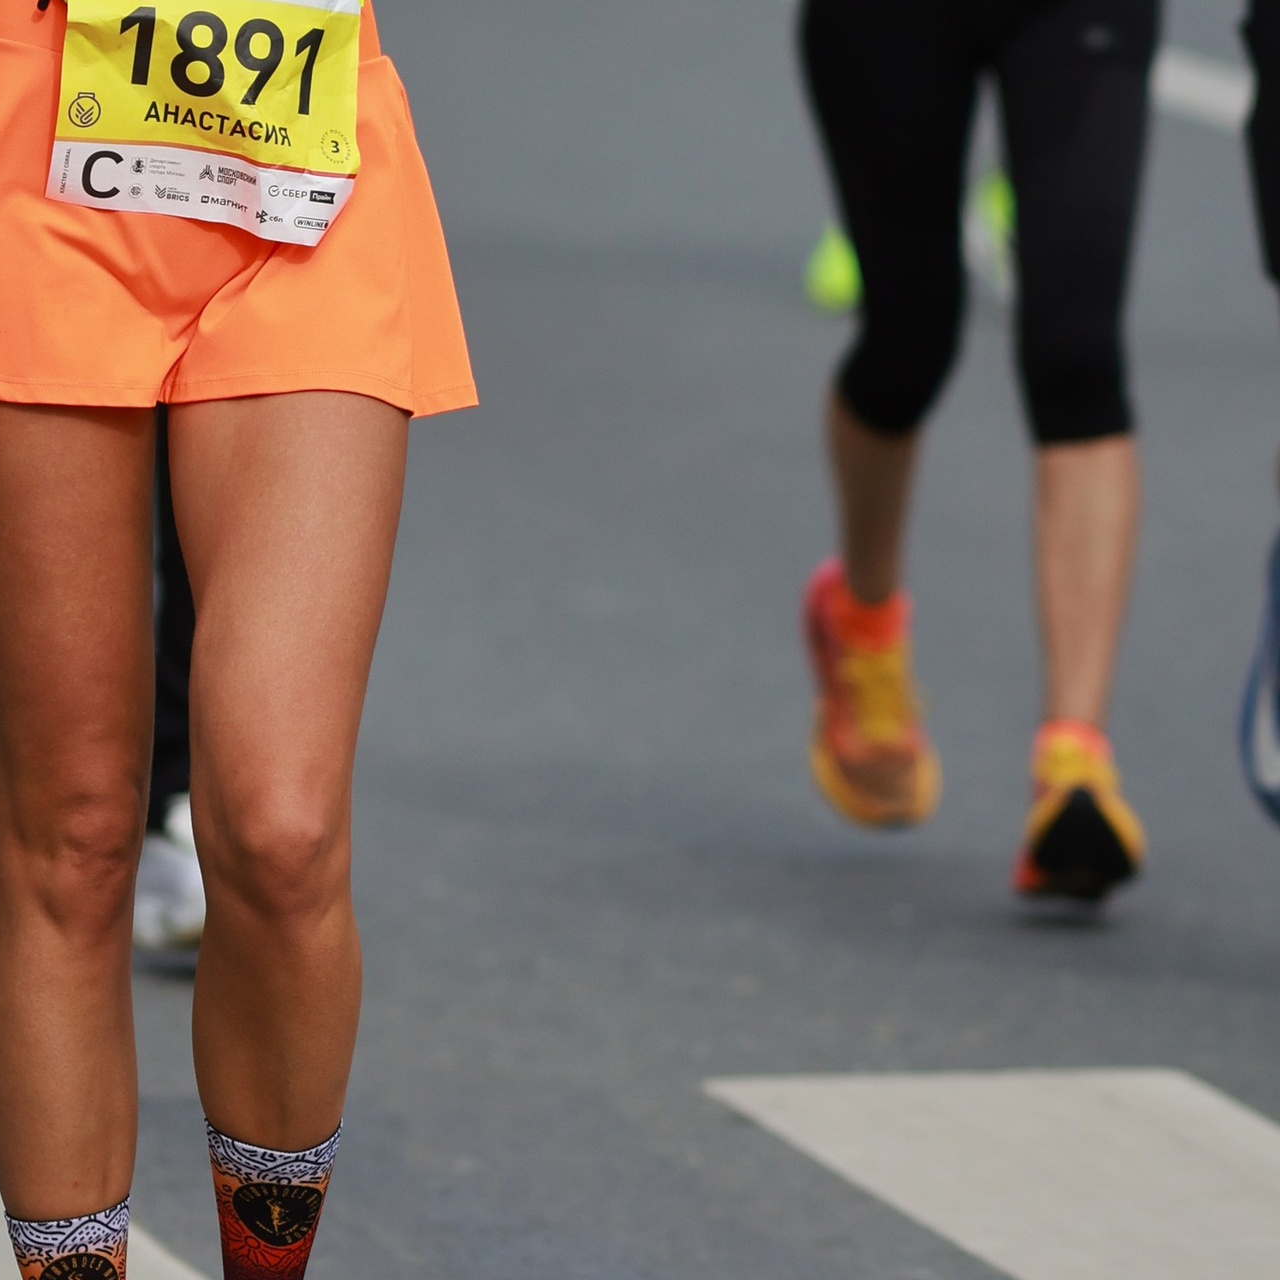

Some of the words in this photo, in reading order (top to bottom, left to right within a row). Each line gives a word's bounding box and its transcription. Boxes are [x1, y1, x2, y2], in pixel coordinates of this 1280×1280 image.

[120, 6, 325, 116] 1891
[144, 101, 292, 148] АНАСТАСИЯ
[330, 140, 340, 153] 3
[217, 175, 238, 187] СПОРТ
[218, 166, 257, 186] МОСКОВСКИЙ
[166, 193, 190, 202] BRICS
[282, 188, 308, 199] СБЕР
[297, 219, 324, 228] WINLINE
